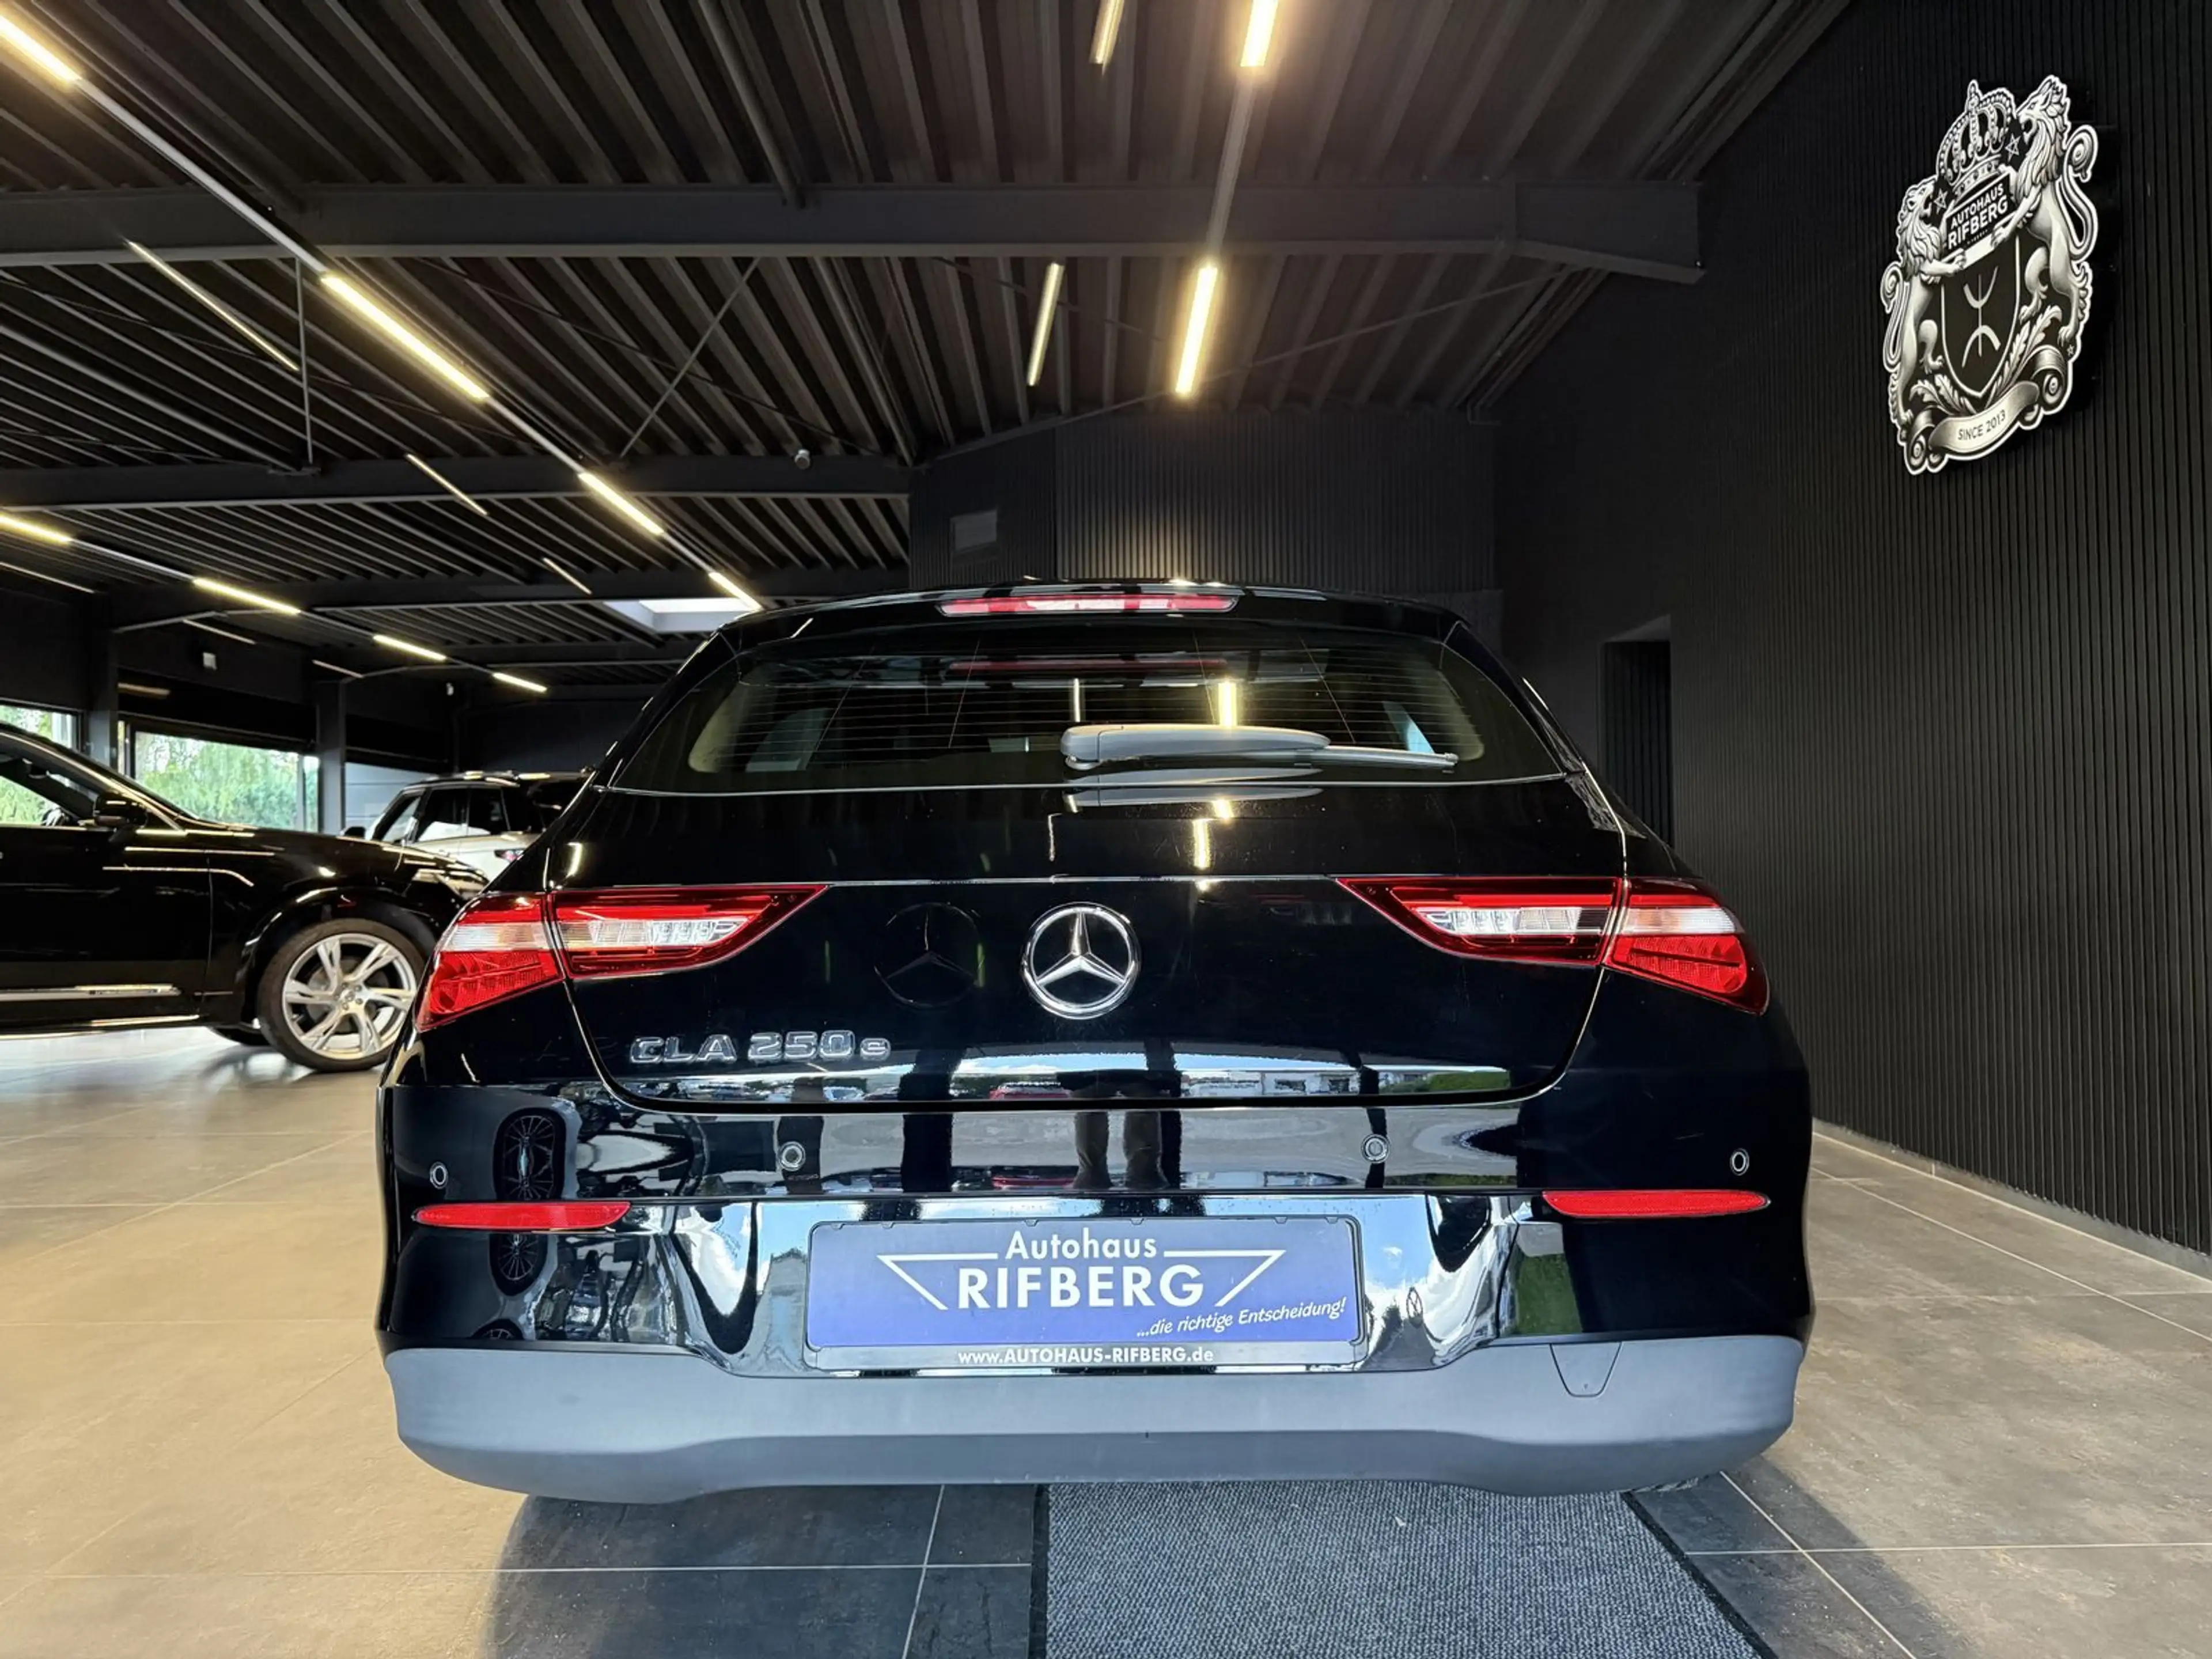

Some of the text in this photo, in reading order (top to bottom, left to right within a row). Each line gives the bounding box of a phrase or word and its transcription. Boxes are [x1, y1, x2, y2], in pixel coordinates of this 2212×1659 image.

[1948, 195, 2008, 249] RIFBERG
[1950, 183, 2004, 230] AUTOHAUS
[1958, 409, 2005, 440] SINCE 2013
[631, 1035, 737, 1064] CLA
[1005, 1228, 1157, 1260] Autohaus
[958, 1264, 1204, 1309] RIFBERG
[1137, 1297, 1347, 1338] ...die richtige Entscheidung!
[958, 1346, 1214, 1363] www.AUTOHAUS-RIFBERG.de
